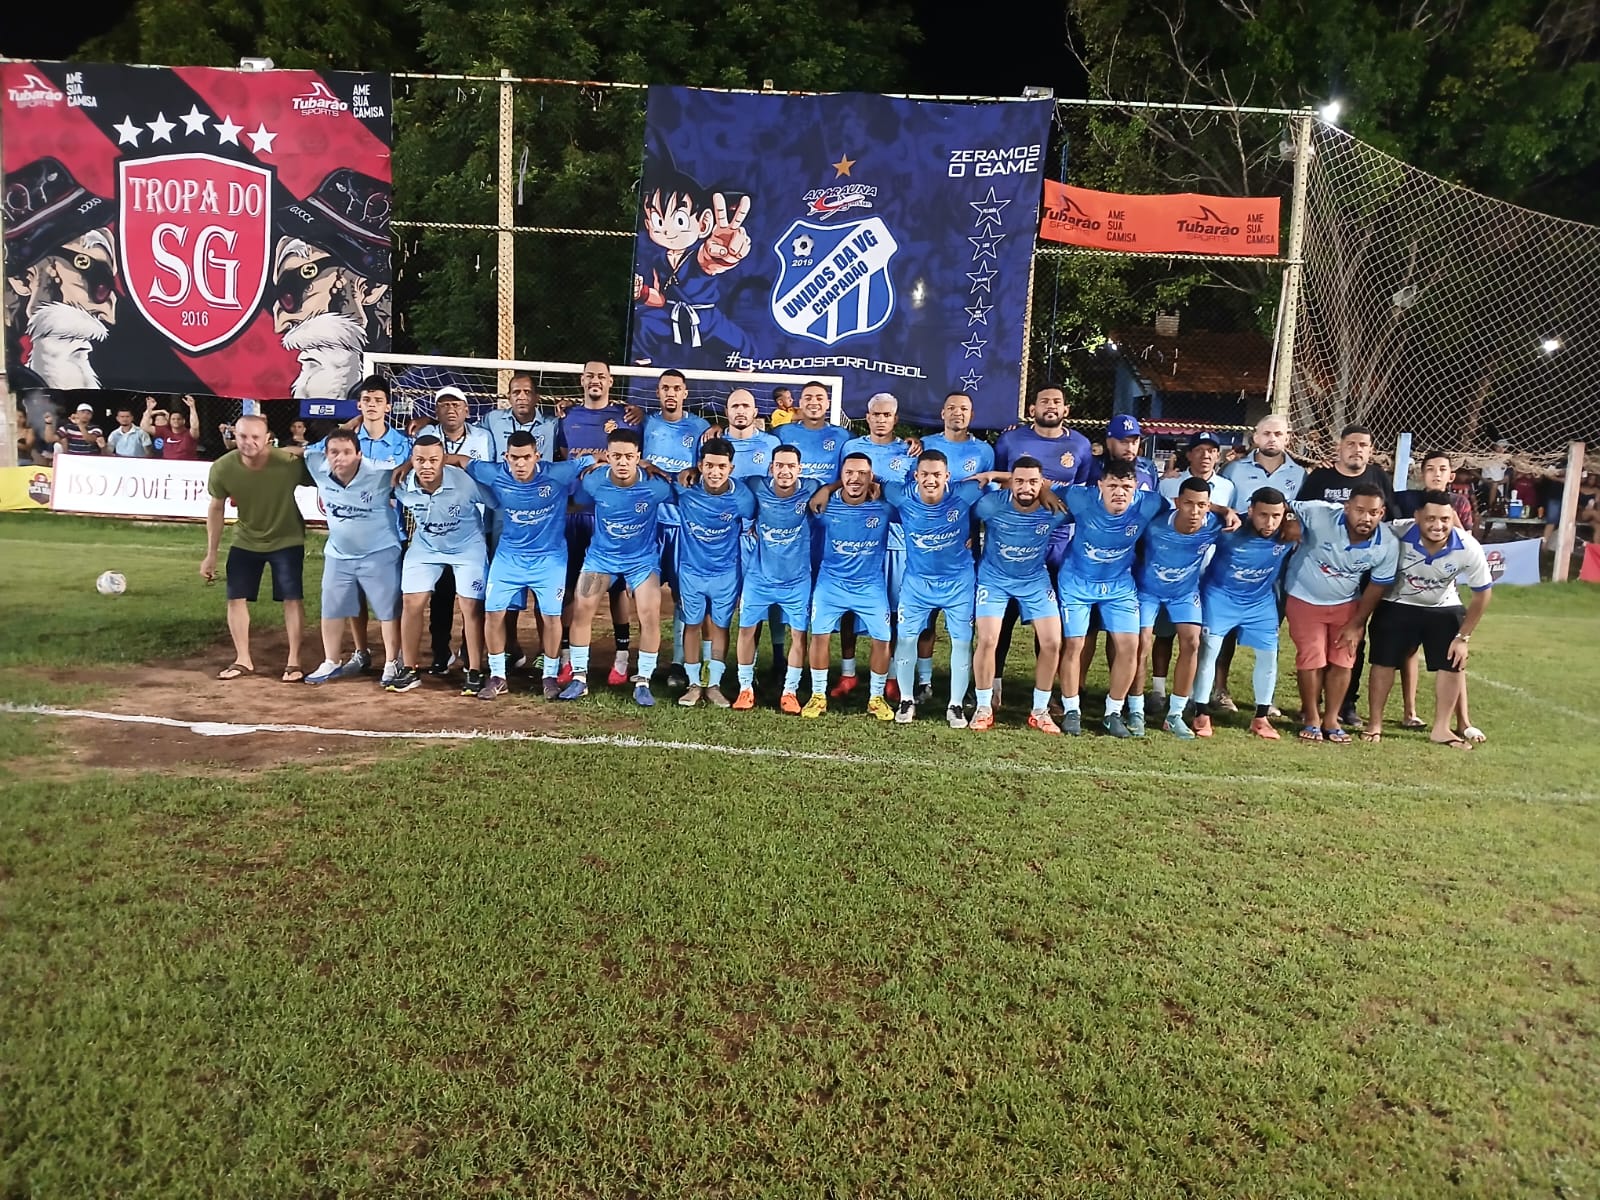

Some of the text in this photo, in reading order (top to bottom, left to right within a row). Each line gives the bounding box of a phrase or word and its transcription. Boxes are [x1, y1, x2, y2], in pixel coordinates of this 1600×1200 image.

[66, 72, 83, 84] AME
[66, 84, 83, 95] SUA
[352, 84, 371, 95] AME
[67, 95, 97, 107] CAMISA
[352, 96, 369, 107] SUA
[301, 108, 339, 117] SPORTS
[353, 106, 384, 118] CAMISA
[949, 145, 1041, 162] ZERAMOS
[948, 157, 1039, 178] O GAME
[128, 177, 264, 217] TROPA DO
[802, 184, 878, 201] ARARAUNA
[1108, 210, 1126, 220] AME
[1247, 213, 1264, 223] AME
[1107, 220, 1123, 231] SUA
[1246, 224, 1261, 234] SUA
[1106, 231, 1136, 242] CAMISA
[1246, 234, 1275, 245] CAMISA
[148, 223, 243, 310] SG
[791, 258, 813, 267] 2019
[782, 229, 879, 319] UNIDOS DA VG
[811, 260, 869, 316] CHAPADÃO
[182, 311, 209, 326] 2016
[725, 351, 927, 379] #CHAPADOSPORFUTEBOL
